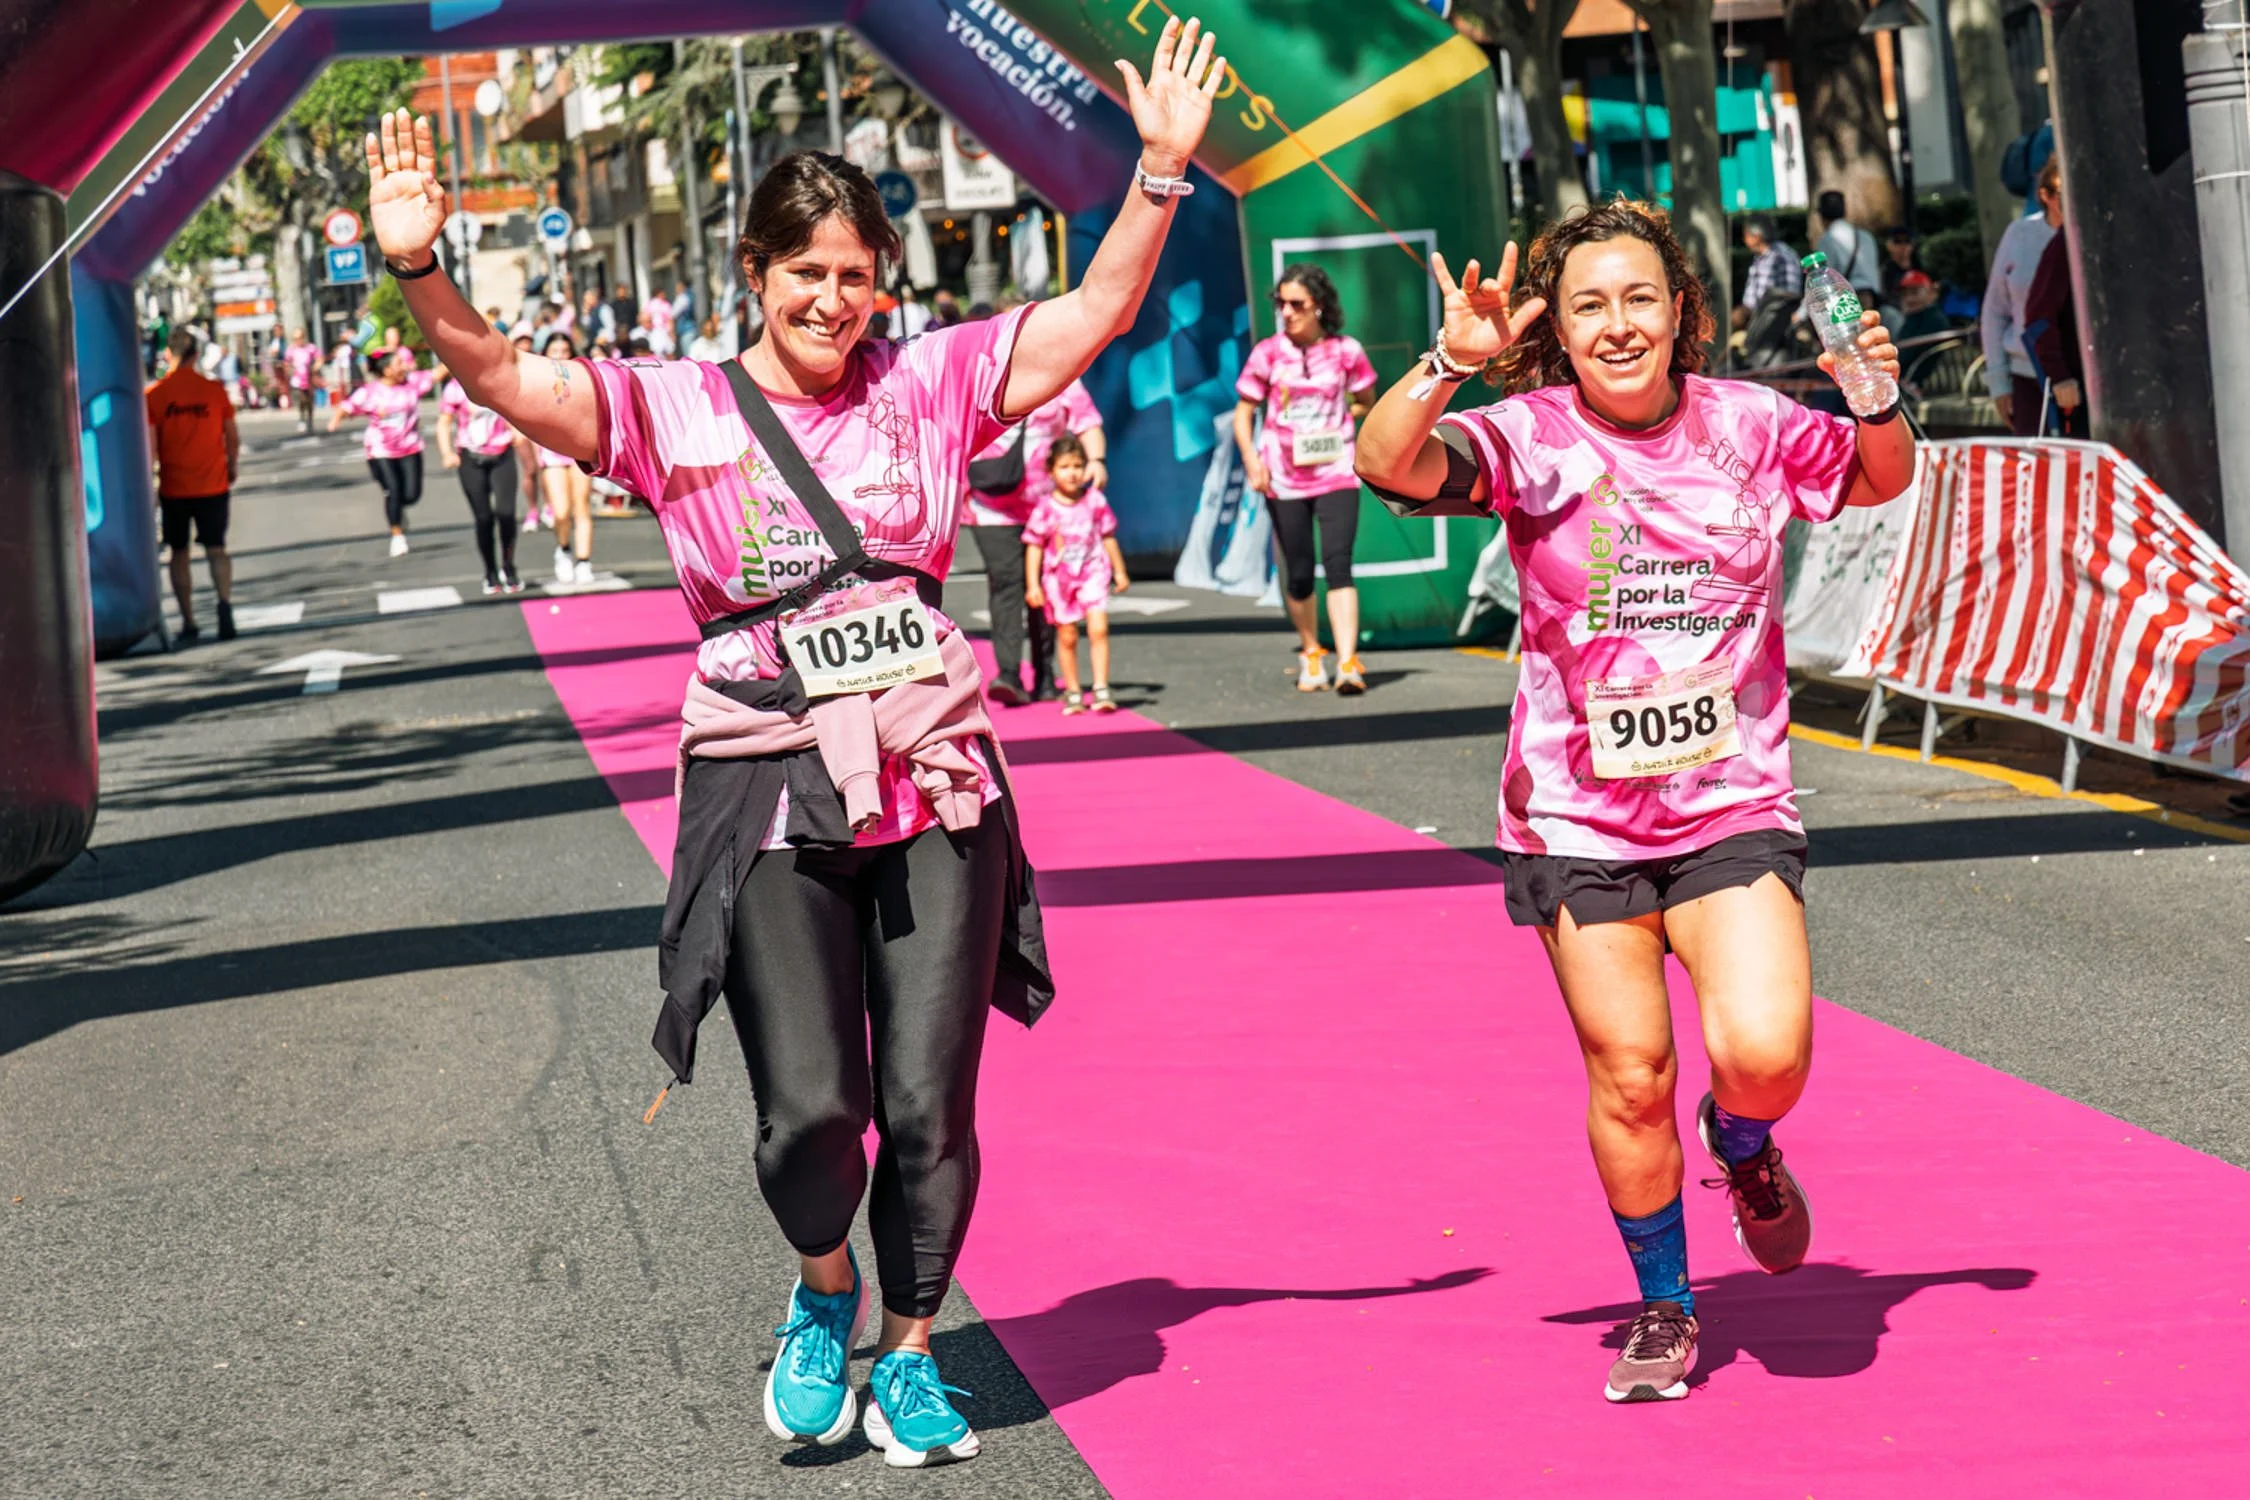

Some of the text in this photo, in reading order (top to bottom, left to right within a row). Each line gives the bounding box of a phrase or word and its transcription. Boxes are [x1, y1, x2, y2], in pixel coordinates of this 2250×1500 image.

[967, 0, 1099, 106] nuestra
[946, 9, 1077, 131] vocación.
[1618, 524, 1642, 545] XI
[768, 557, 814, 582] por
[1580, 519, 1619, 632] mujer
[1617, 553, 1711, 576] Carrera
[1616, 583, 1686, 609] por la
[1614, 610, 1757, 637] Investigacón
[795, 608, 925, 670] 10346
[1609, 694, 1719, 750] 9058
[1696, 776, 1727, 791] Ferrer
